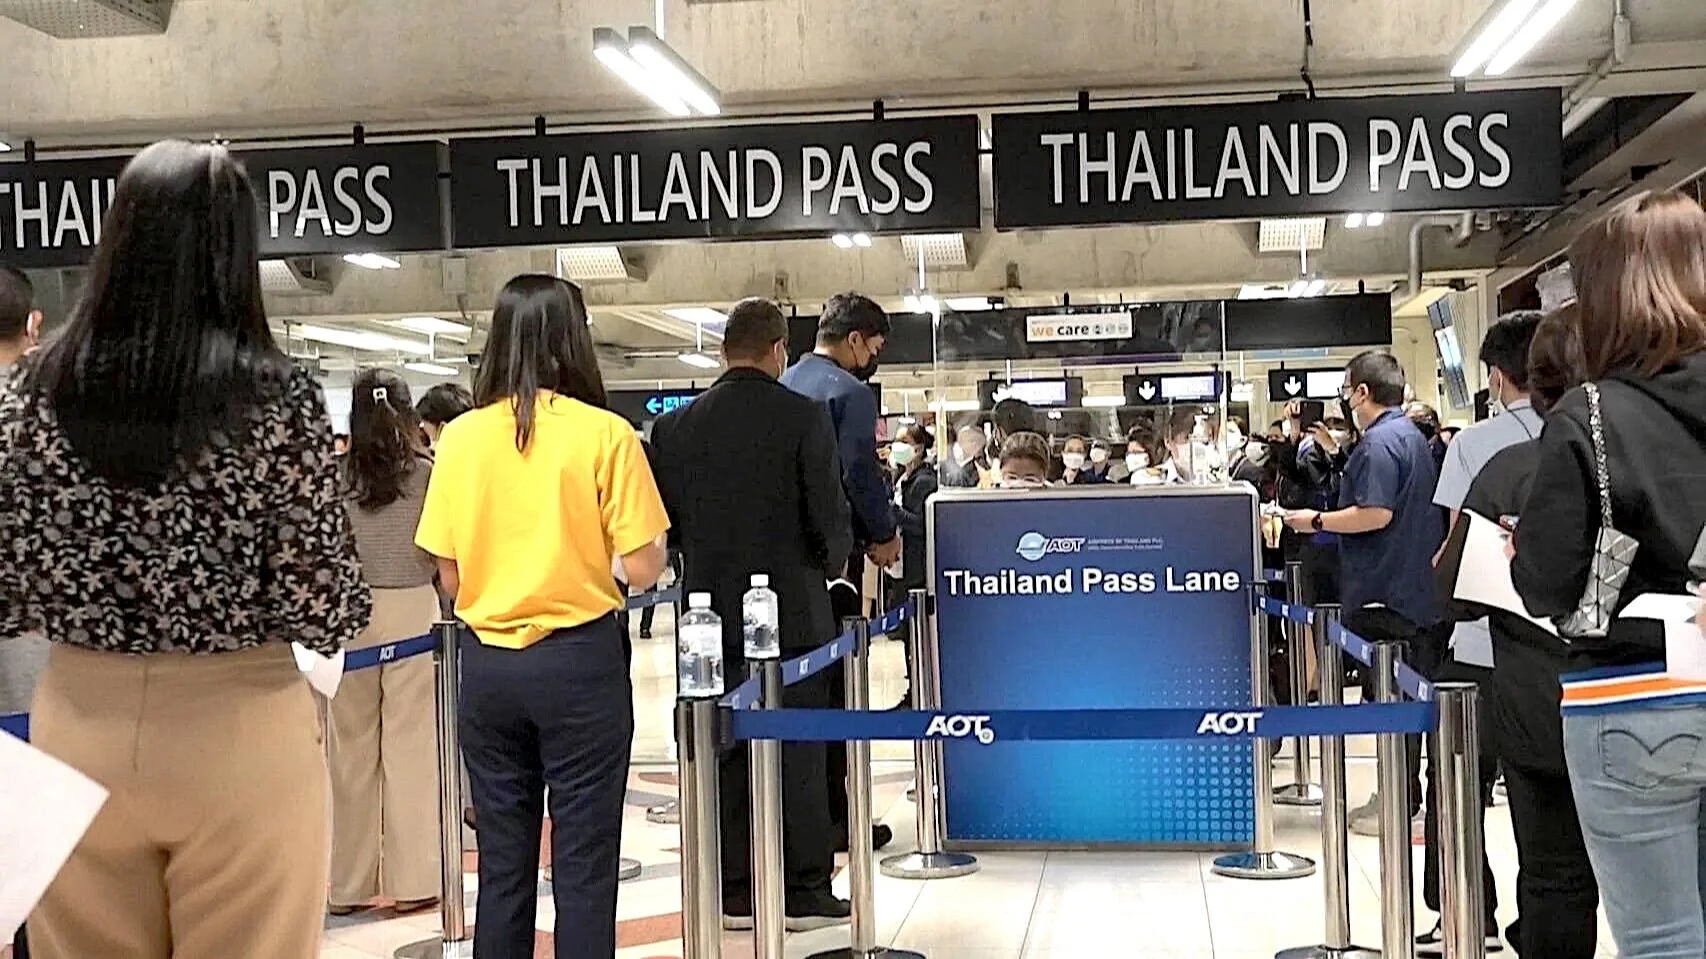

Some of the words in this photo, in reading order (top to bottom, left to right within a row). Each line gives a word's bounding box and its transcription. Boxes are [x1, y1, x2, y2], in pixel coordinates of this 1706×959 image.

[1041, 122, 1348, 204] THAILAND
[1369, 113, 1510, 192] PASS
[498, 150, 782, 226] THAILAND
[801, 142, 932, 216] PASS
[269, 166, 392, 237] PASS
[1032, 326, 1054, 336] we
[1057, 325, 1089, 335] care
[1046, 538, 1085, 552] AOT
[944, 569, 1073, 595] Thailand
[1083, 567, 1156, 593] Pass
[1166, 567, 1240, 592] Lane
[925, 715, 991, 737] AOT
[1197, 712, 1263, 735] AOT
